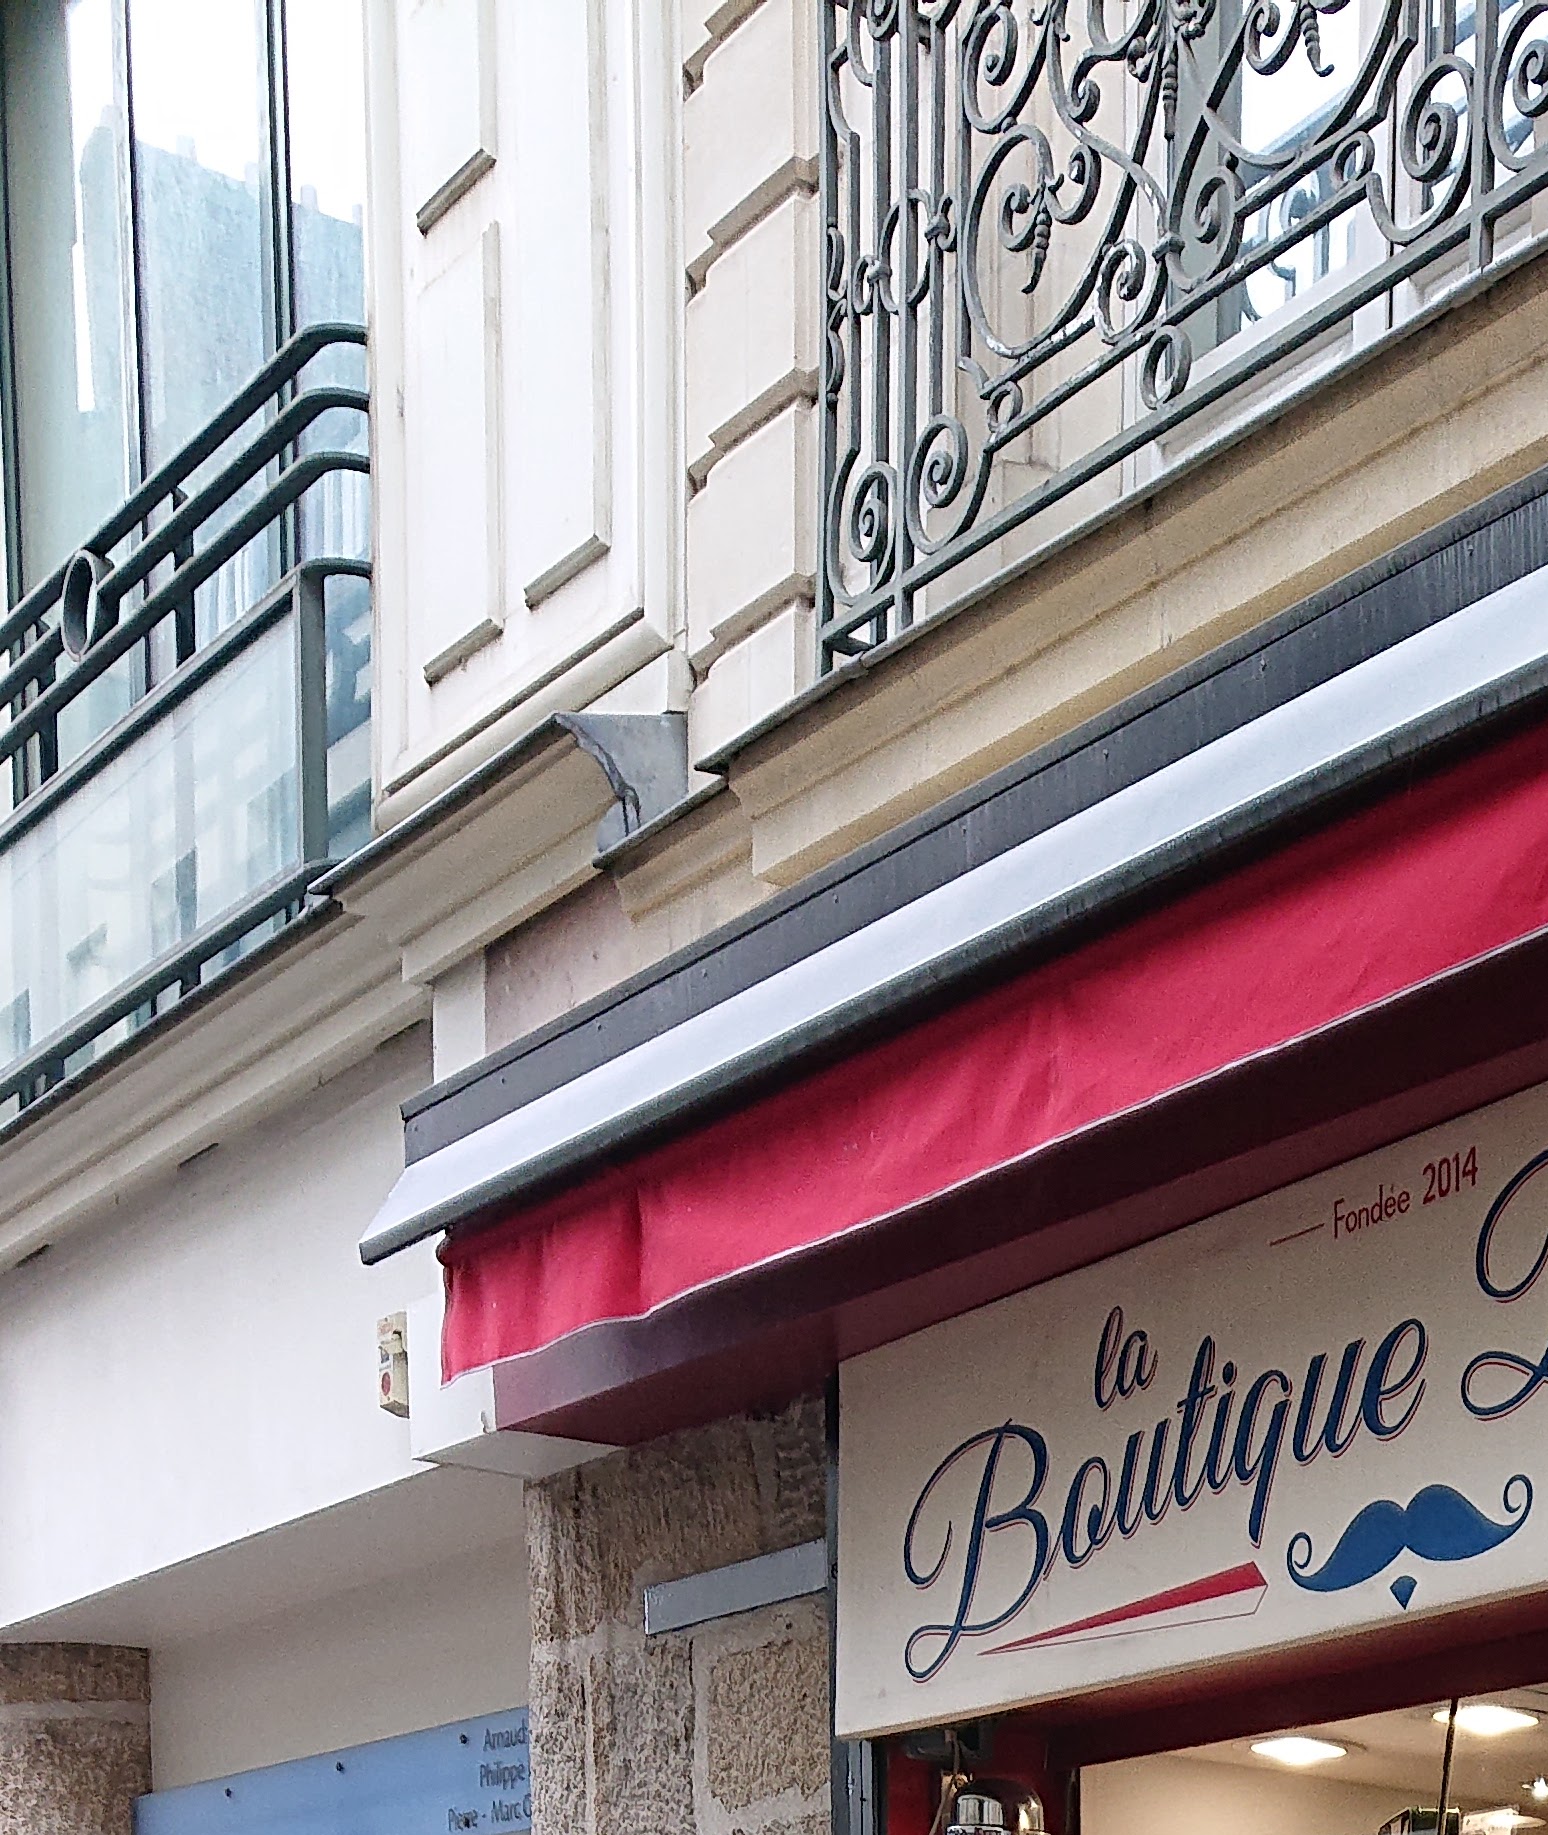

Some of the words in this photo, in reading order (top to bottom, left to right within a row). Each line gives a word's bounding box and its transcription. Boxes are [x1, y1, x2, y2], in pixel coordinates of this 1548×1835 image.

[1333, 1184, 1411, 1239] Fondée
[1422, 1145, 1479, 1205] 2014
[1095, 1305, 1158, 1411] la
[903, 1318, 1429, 1683] Boutique
[479, 1761, 526, 1790] Philippe
[490, 1799, 521, 1823] Marc
